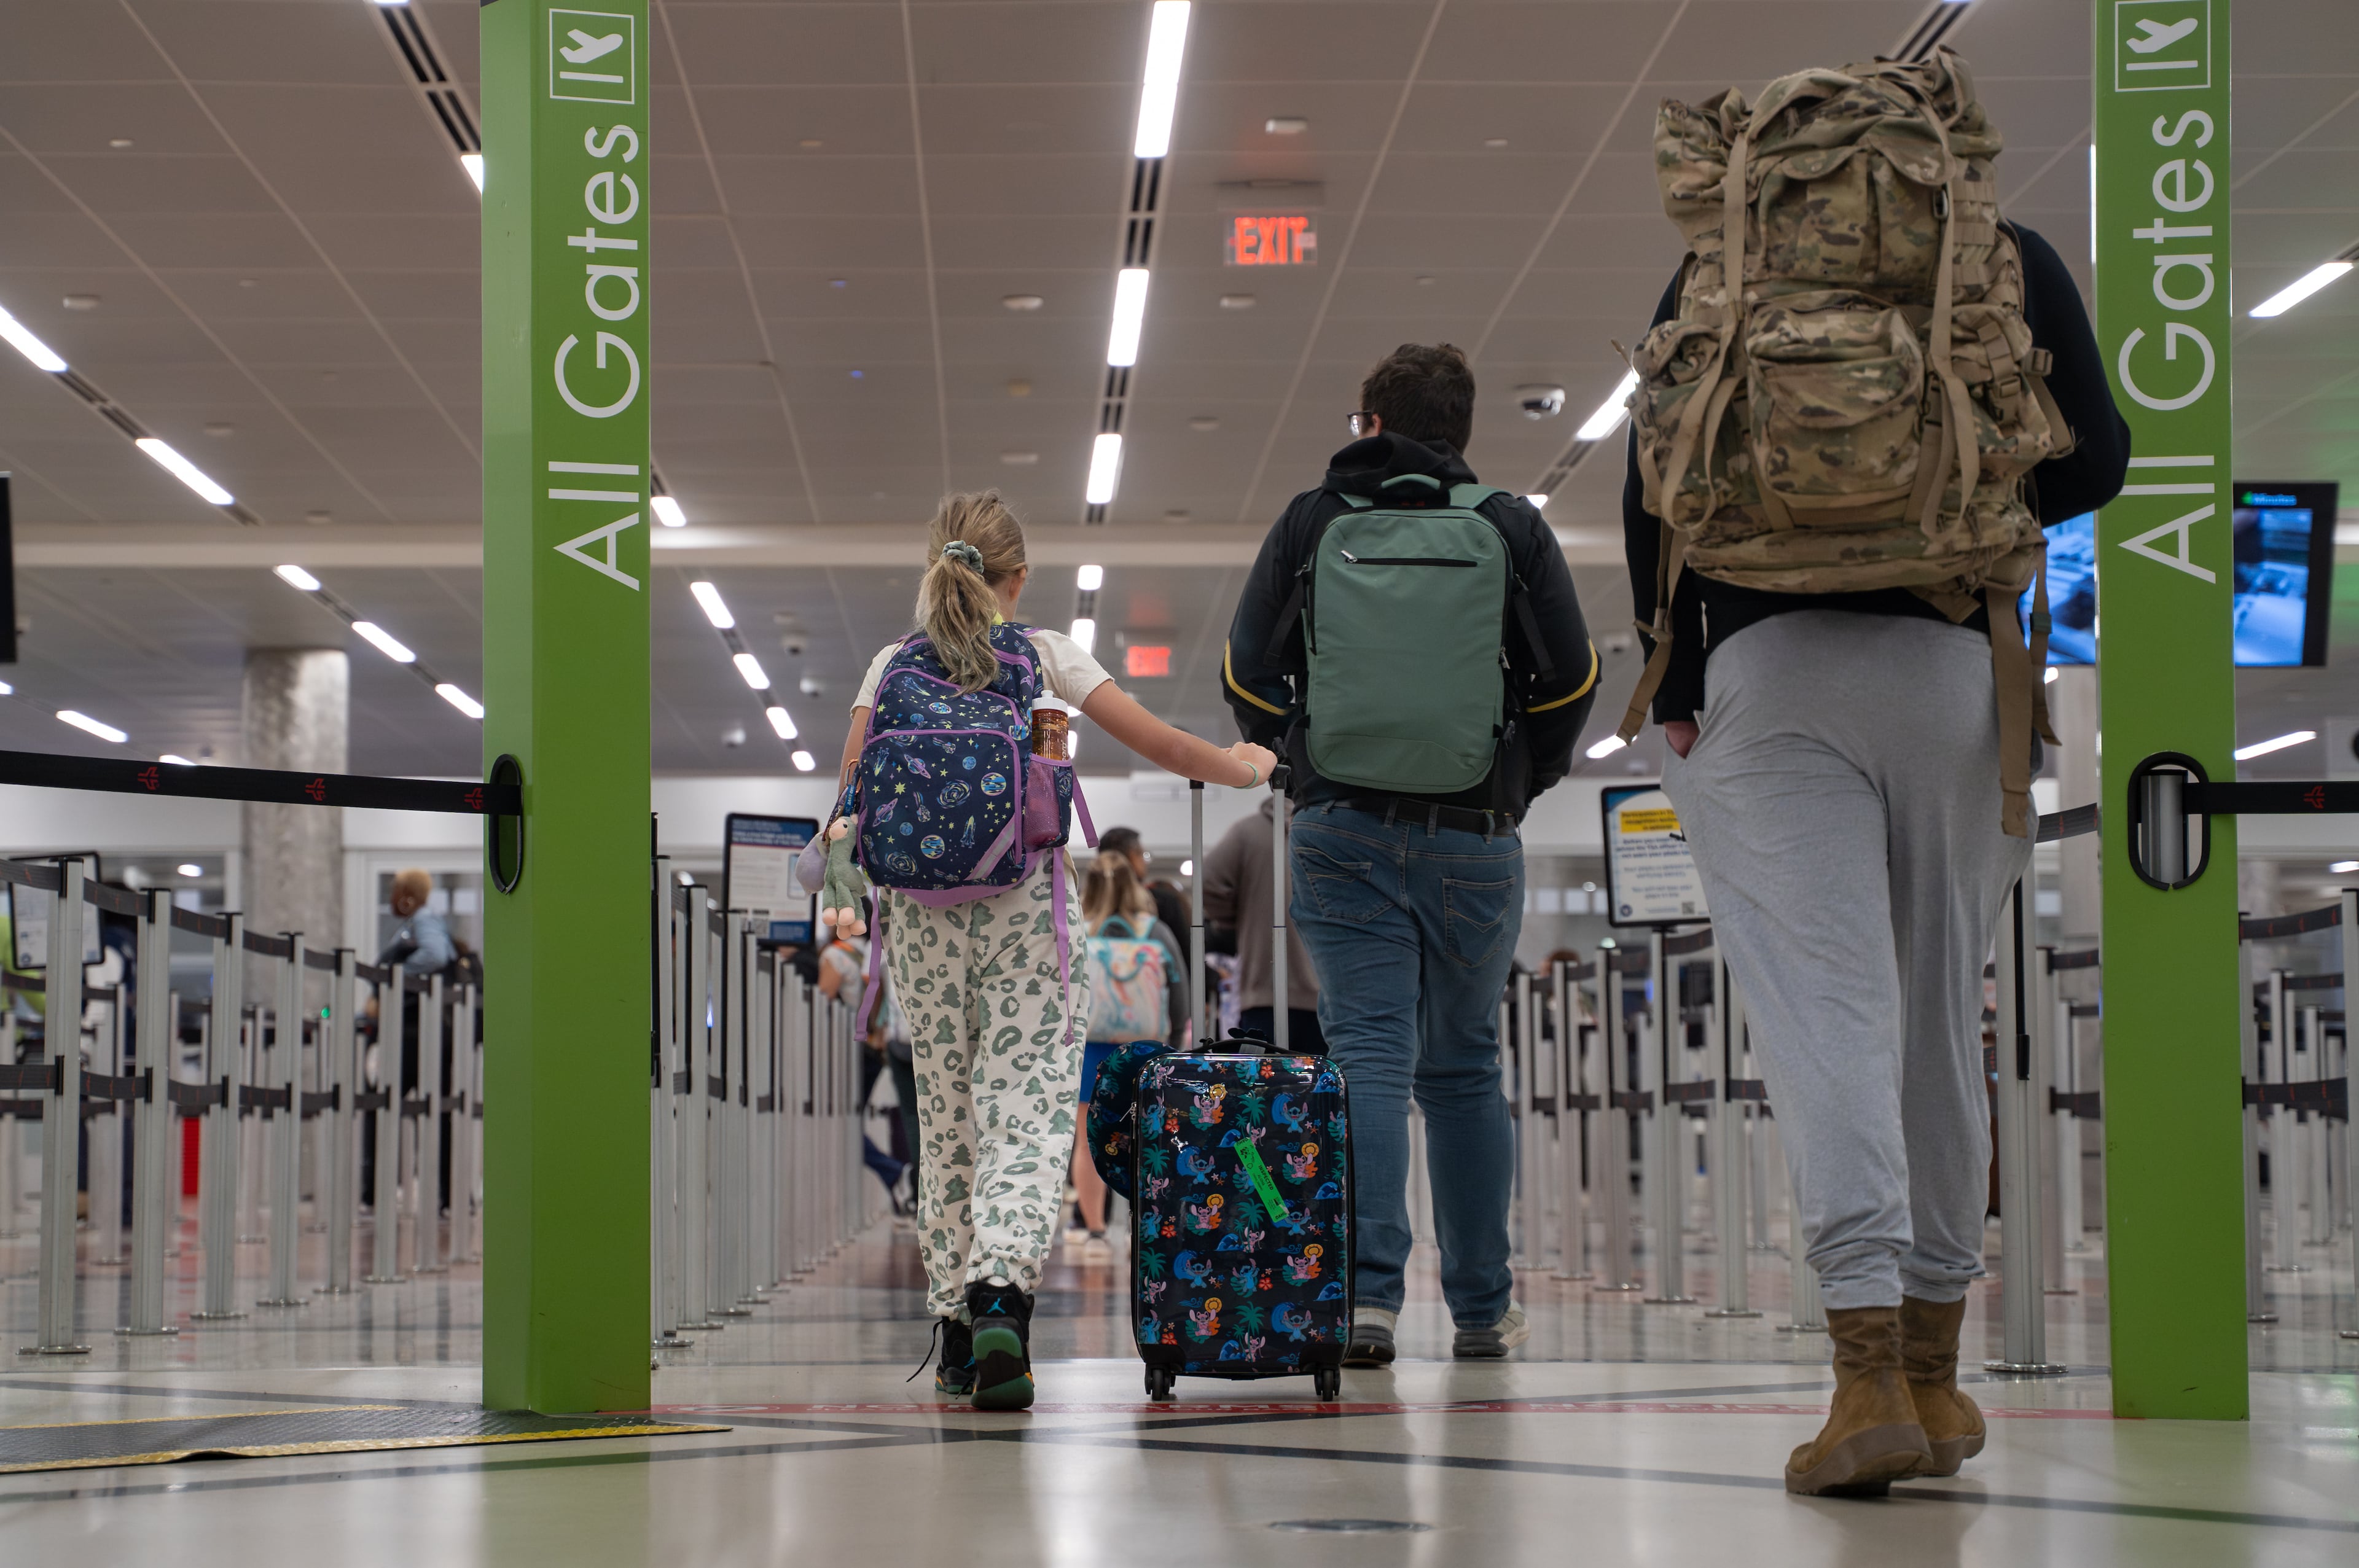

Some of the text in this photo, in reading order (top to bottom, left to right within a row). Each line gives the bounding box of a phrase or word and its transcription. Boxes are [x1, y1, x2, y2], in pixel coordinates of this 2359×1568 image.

[549, 123, 640, 591] All Gates
[1234, 217, 1308, 265] EXIT
[2118, 110, 2216, 584] All Gates
[1258, 1165, 1273, 1191] INSPECTED
